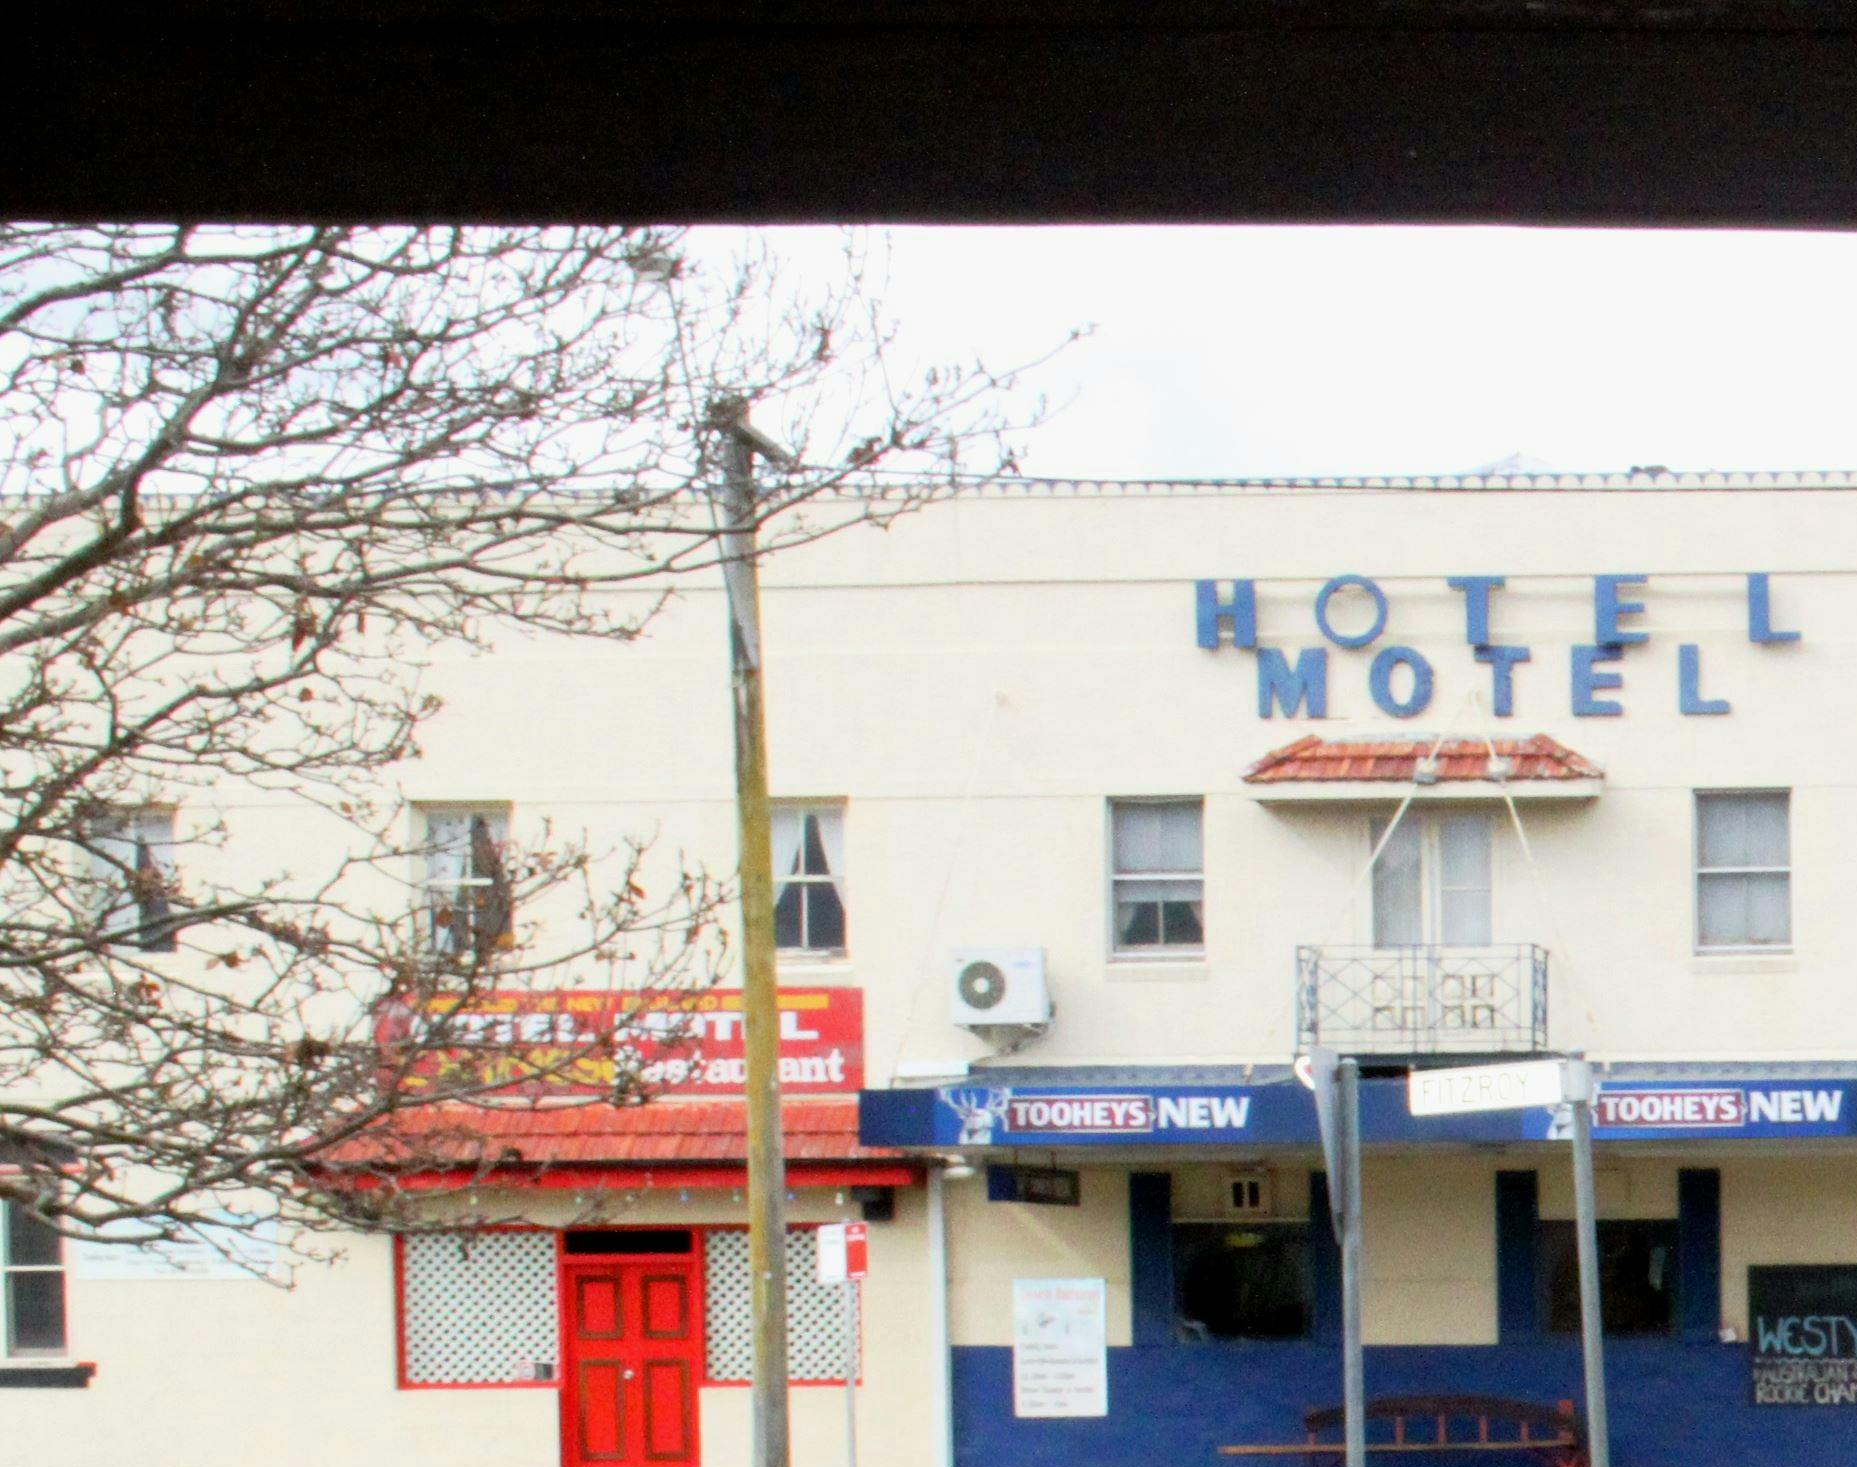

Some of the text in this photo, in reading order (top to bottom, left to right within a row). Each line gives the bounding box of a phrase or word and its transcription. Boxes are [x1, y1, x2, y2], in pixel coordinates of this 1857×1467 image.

[1194, 573, 1801, 650] HOTEL
[1256, 644, 1731, 719] MOTEL
[613, 1010, 820, 1041] MOTL
[614, 1047, 846, 1084] Restauant
[1422, 1071, 1530, 1105] FITZROY
[1013, 1096, 1250, 1128] TOOHEYS NEW
[1601, 1090, 1843, 1122] TOOHEYS NEW
